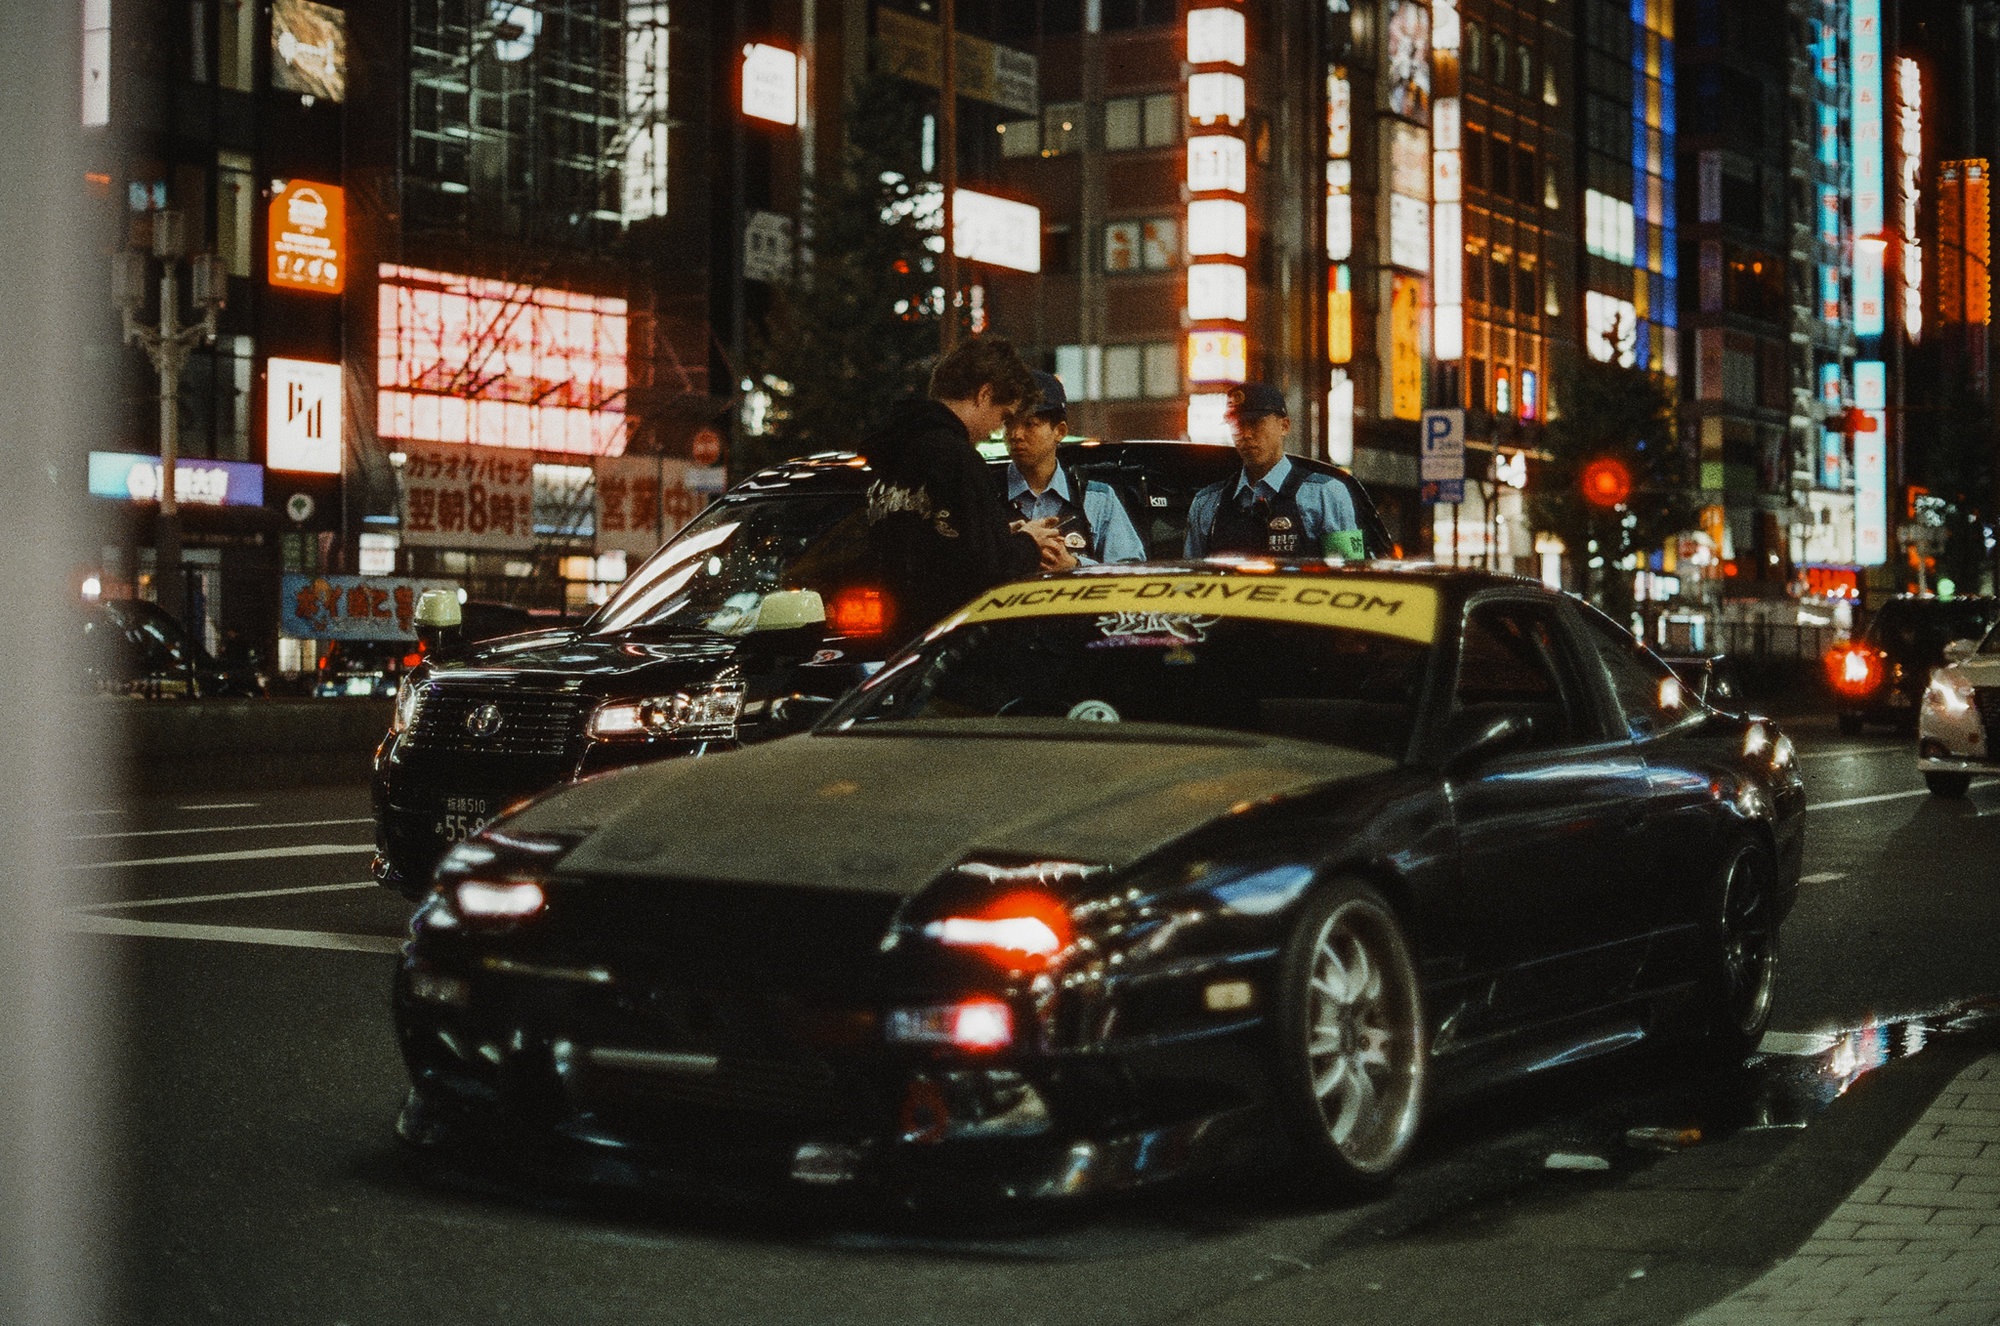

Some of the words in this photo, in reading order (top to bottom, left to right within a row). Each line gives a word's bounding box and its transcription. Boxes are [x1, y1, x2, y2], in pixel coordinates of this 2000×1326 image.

[1427, 415, 1451, 450] P
[1150, 496, 1167, 507] km
[979, 582, 1404, 616] NICHE-DRIVE.COM
[467, 798, 486, 814] 510
